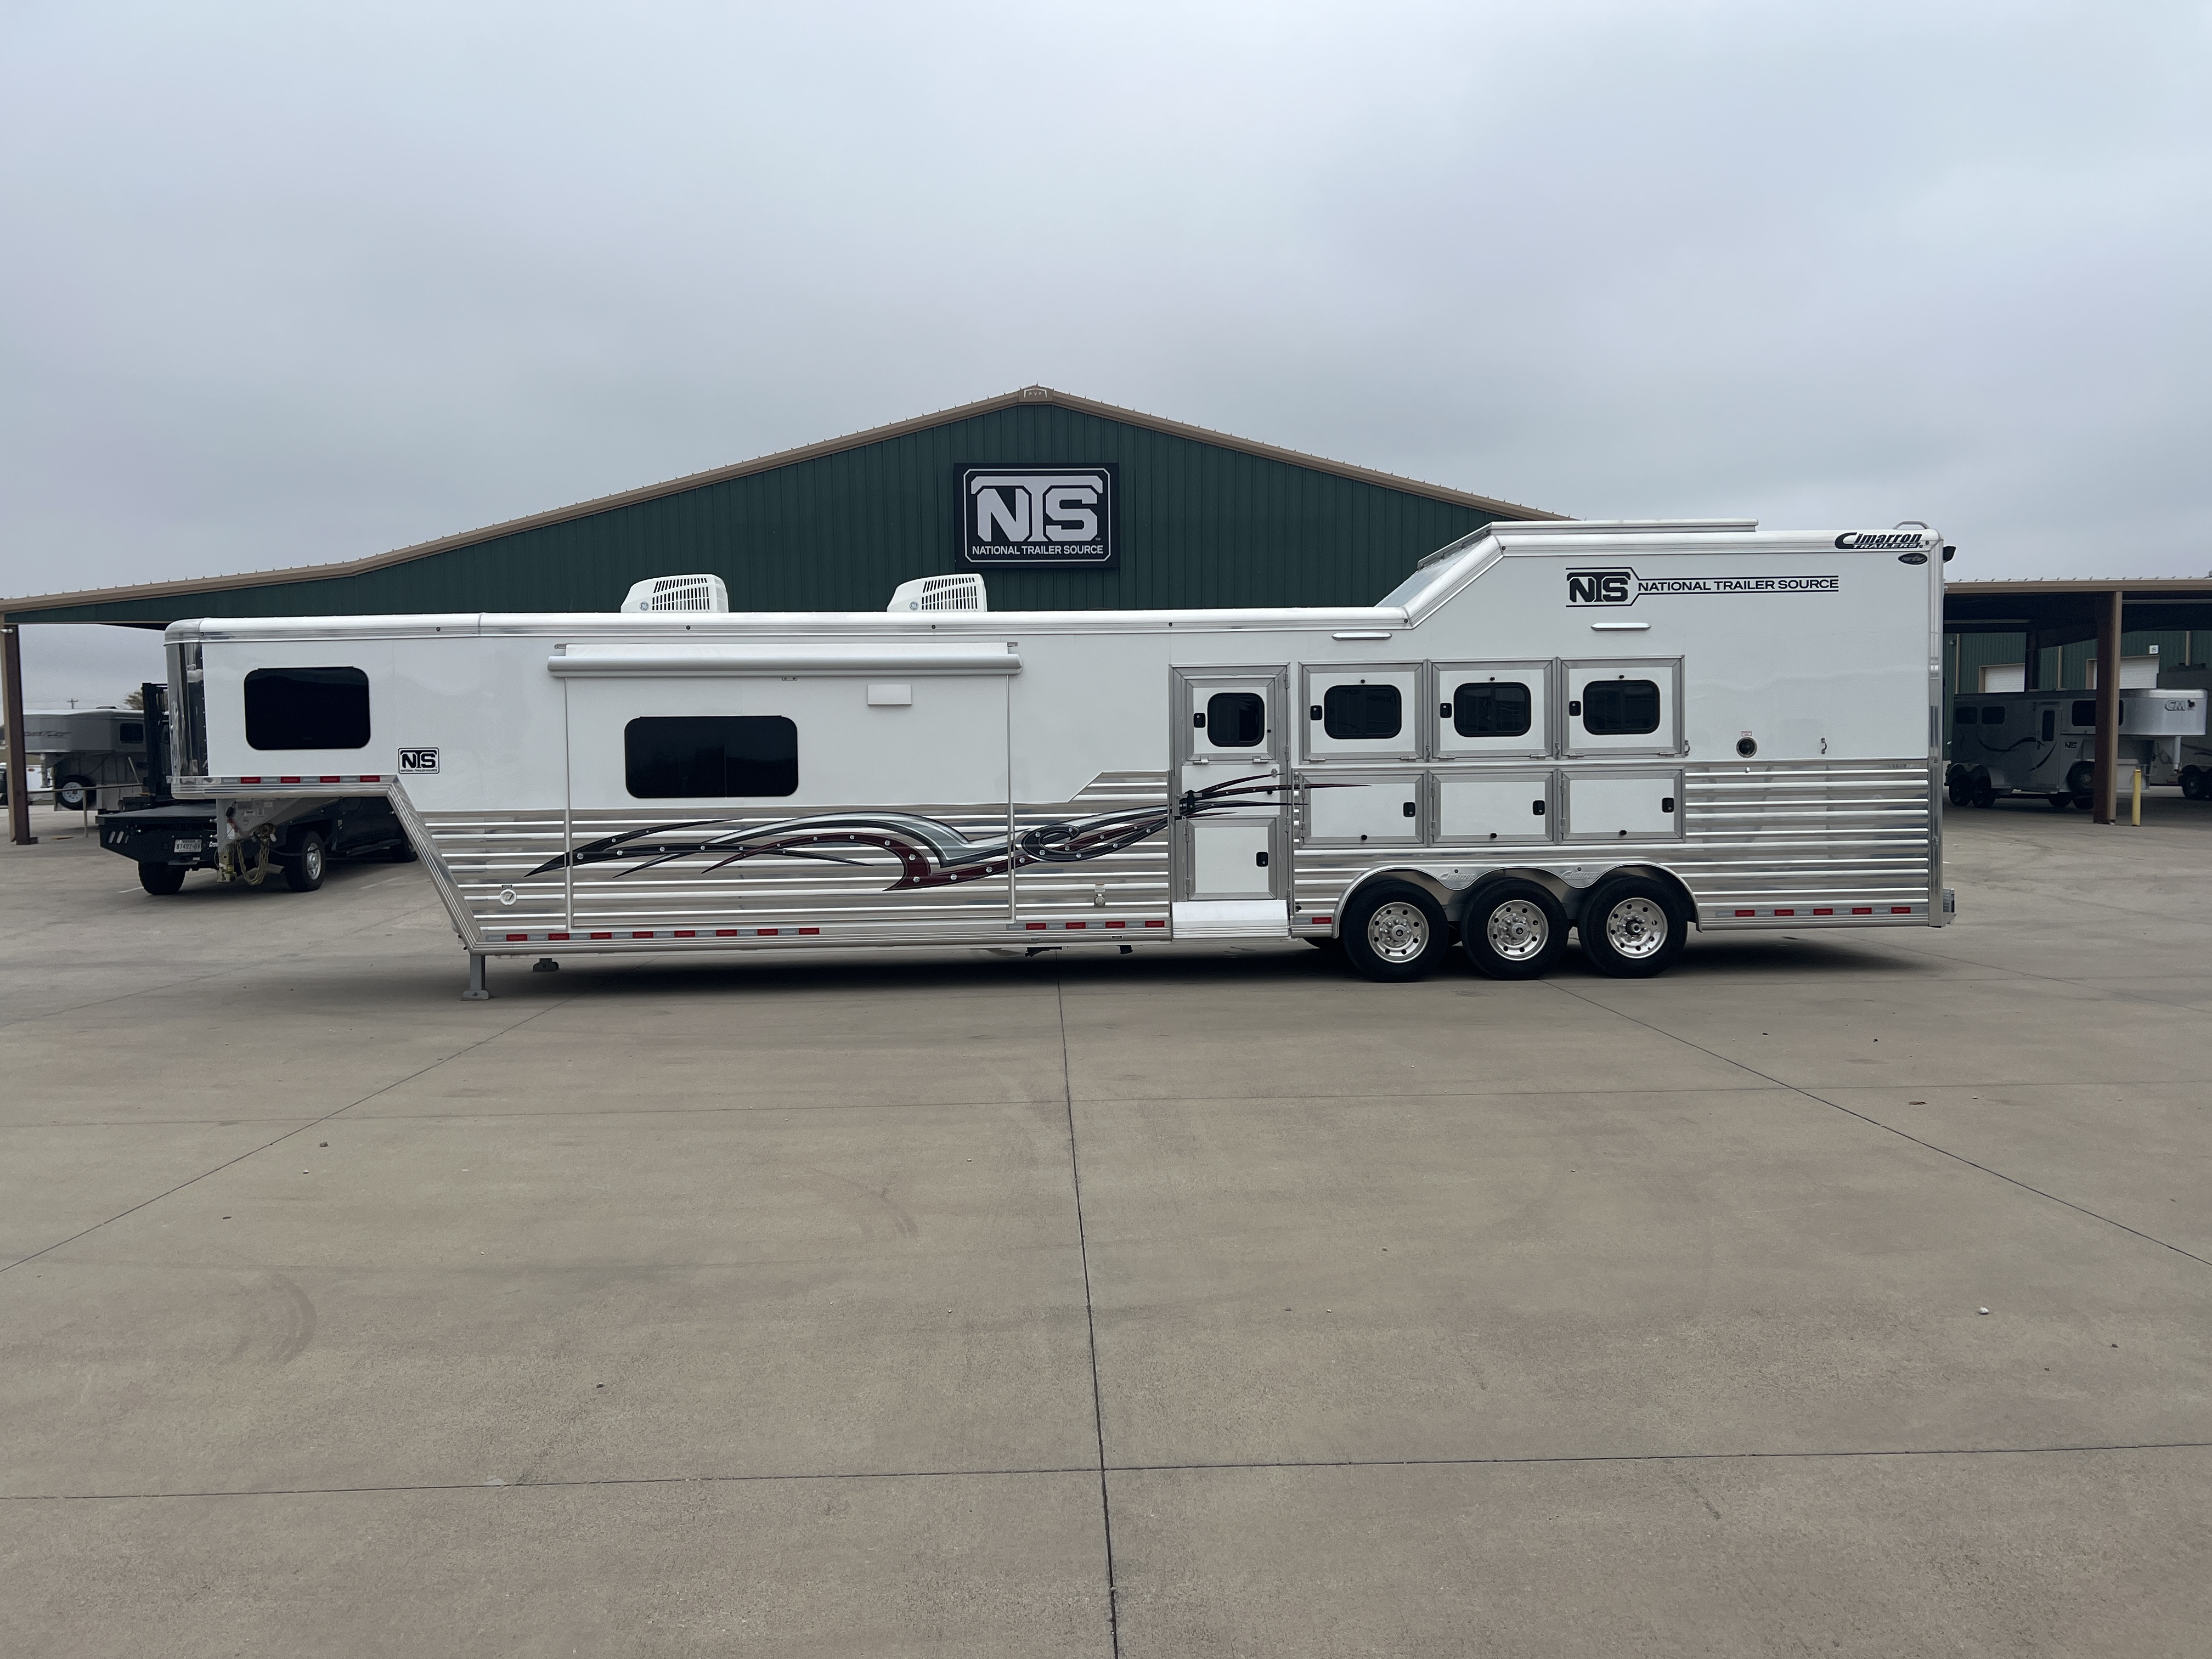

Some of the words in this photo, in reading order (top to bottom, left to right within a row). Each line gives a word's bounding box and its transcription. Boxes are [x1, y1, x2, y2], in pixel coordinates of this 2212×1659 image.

[971, 476, 1103, 541] NTS
[1835, 532, 1922, 549] Cimarron
[972, 545, 1020, 555] NATIONAL
[1021, 545, 1062, 555] TRAILER
[1063, 545, 1104, 555] SOURCE
[1566, 571, 1631, 603] NTS
[1638, 580, 1712, 592] NATIONAL
[1714, 580, 1775, 591] TRAILER
[1778, 579, 1839, 590] SOURCE
[2165, 699, 2186, 711] CM
[400, 750, 437, 768] NTS
